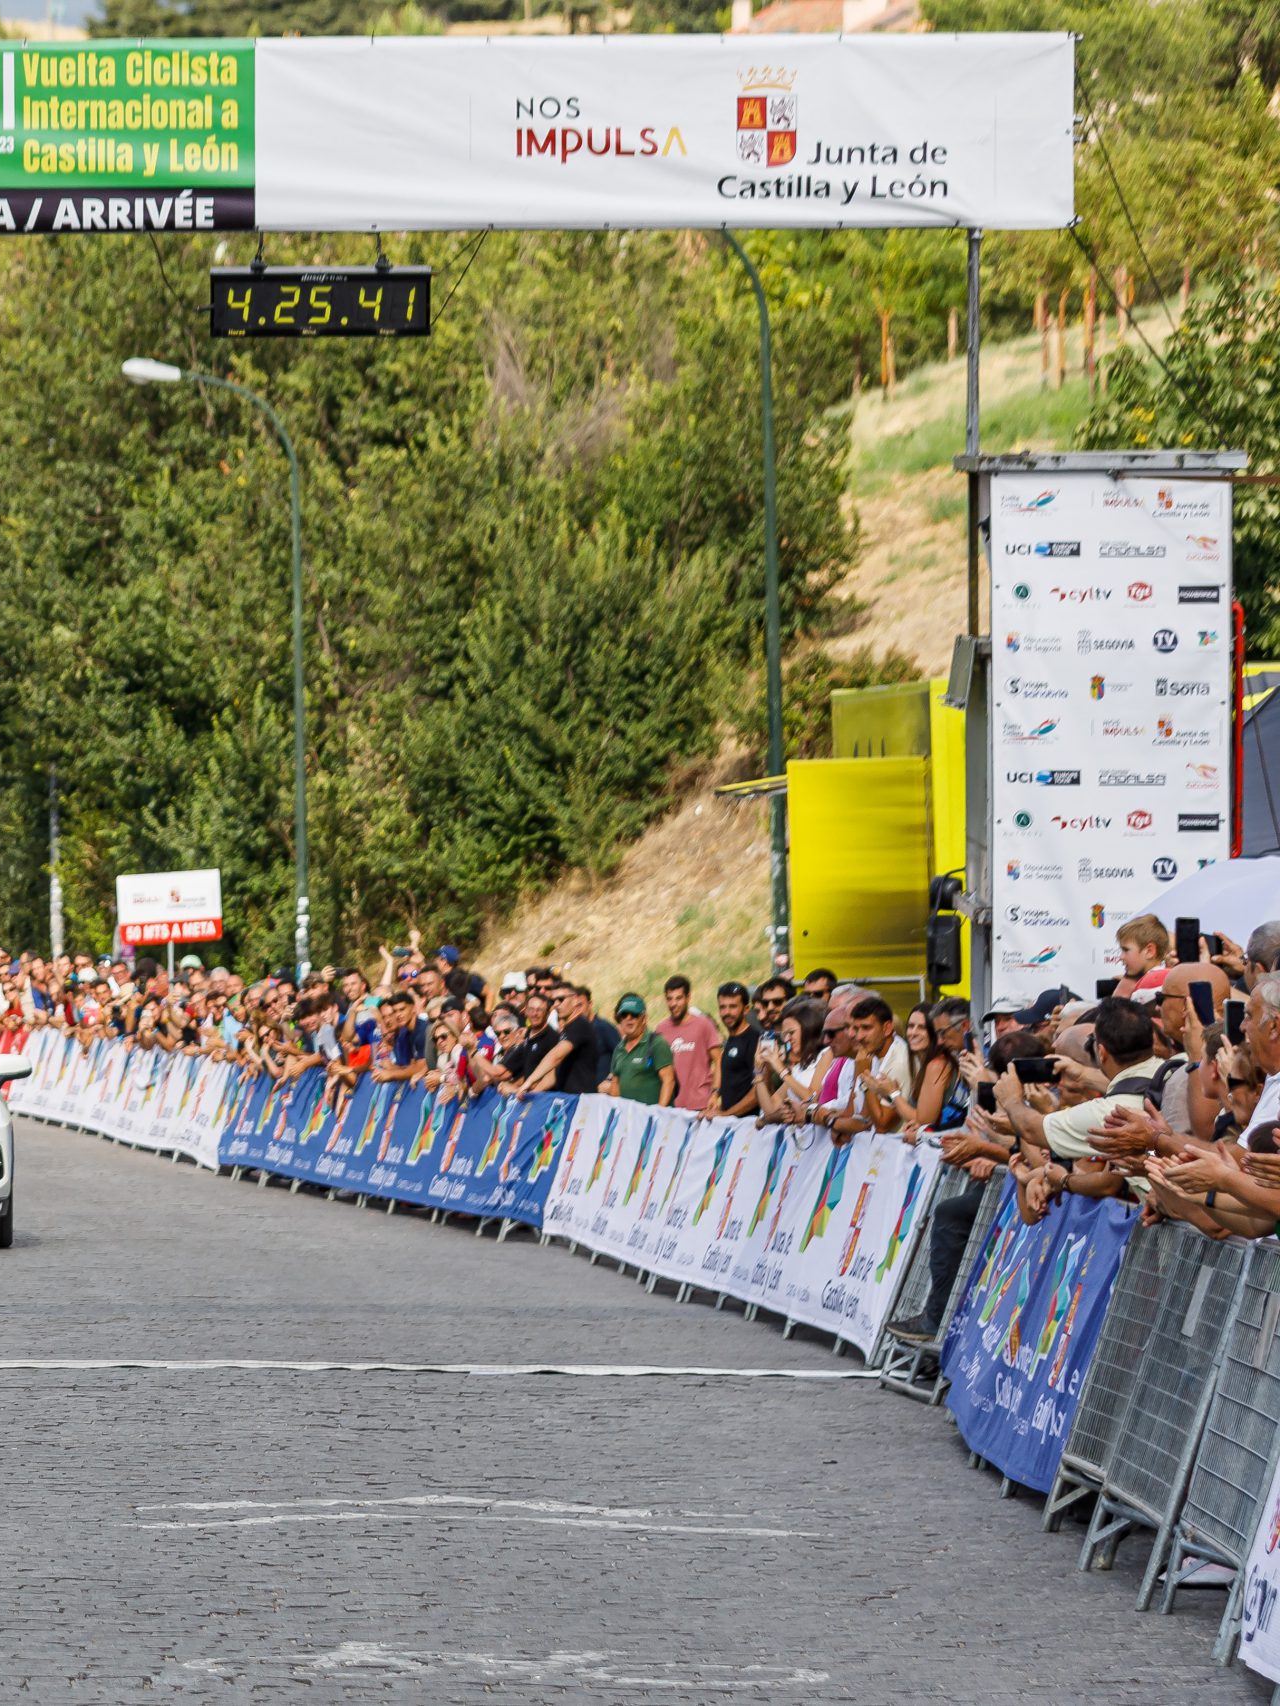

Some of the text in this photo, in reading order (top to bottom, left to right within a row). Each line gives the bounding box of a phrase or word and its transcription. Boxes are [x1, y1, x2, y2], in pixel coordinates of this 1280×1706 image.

[23, 50, 238, 87] Vuelta Ciclista
[23, 93, 238, 130] Internacional a
[515, 97, 581, 120] NOS
[23, 134, 238, 177] Castilla y León
[515, 126, 688, 164] IMPULSA
[806, 140, 948, 166] Junta de
[717, 173, 948, 205] Castilla y León
[23, 197, 43, 232] /
[52, 189, 215, 231] ARRIVÉE
[1006, 544, 1031, 555] UCI
[1007, 772, 1032, 783] UCI
[1070, 815, 1112, 831] cyltv
[143, 923, 170, 940] MTS
[171, 922, 181, 938] A
[182, 919, 216, 938] META
